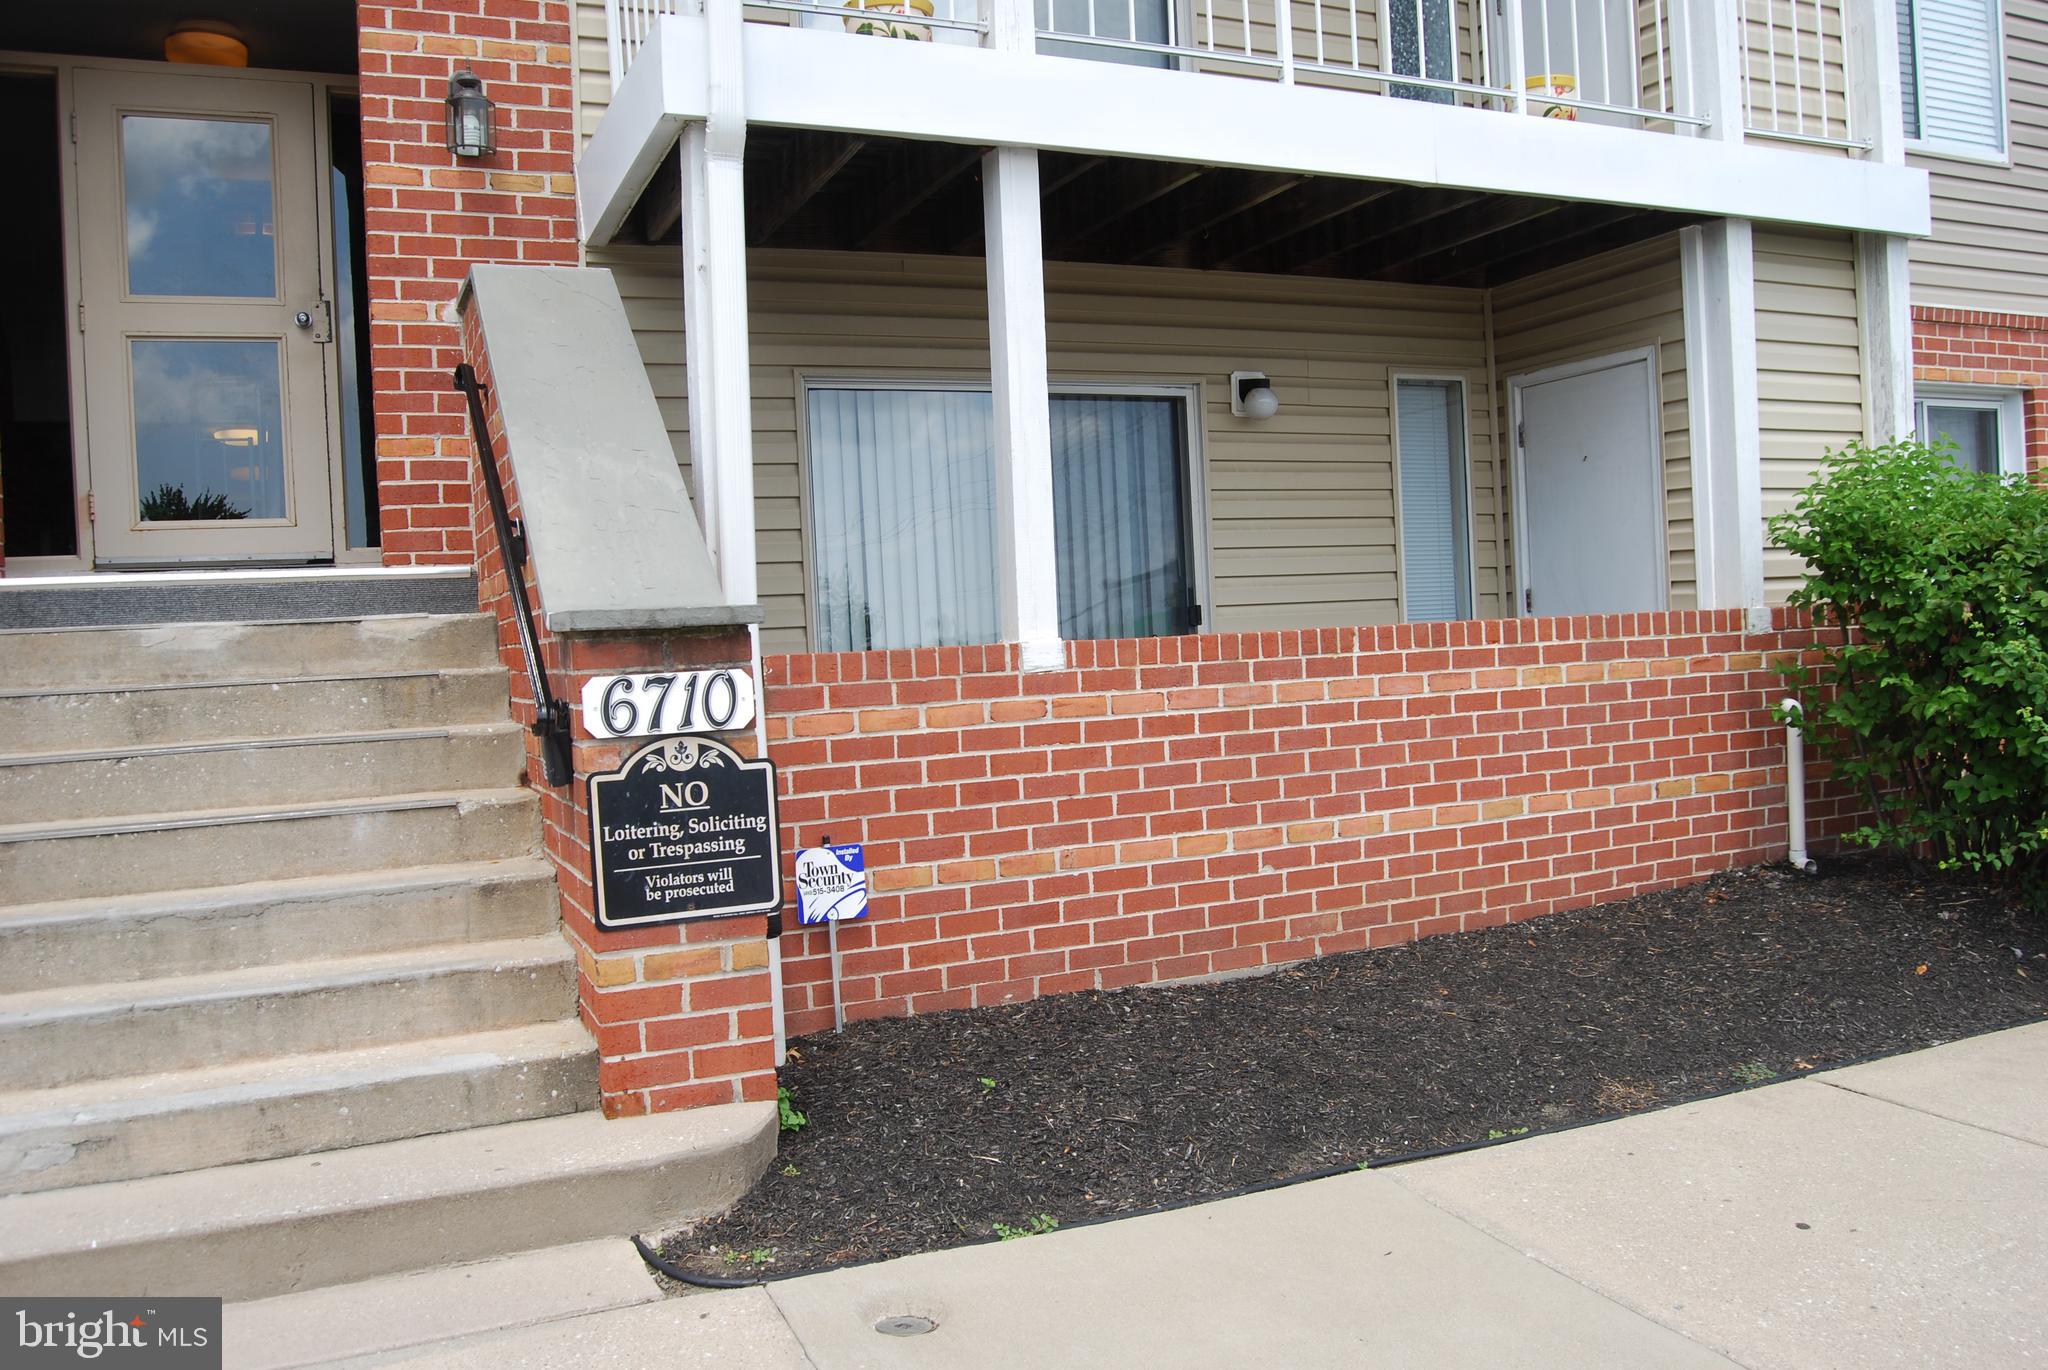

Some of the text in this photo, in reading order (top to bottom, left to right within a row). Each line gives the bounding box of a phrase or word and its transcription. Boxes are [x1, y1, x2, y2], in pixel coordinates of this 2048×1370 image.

[600, 670, 738, 735] 6710
[659, 780, 710, 810] NO
[603, 813, 767, 842] Loitering, Soliciting
[628, 836, 746, 861] or Trespassing
[645, 867, 733, 888] Violators will
[798, 872, 854, 889] Security
[803, 861, 838, 877] Town
[646, 880, 735, 903] be prosecuted
